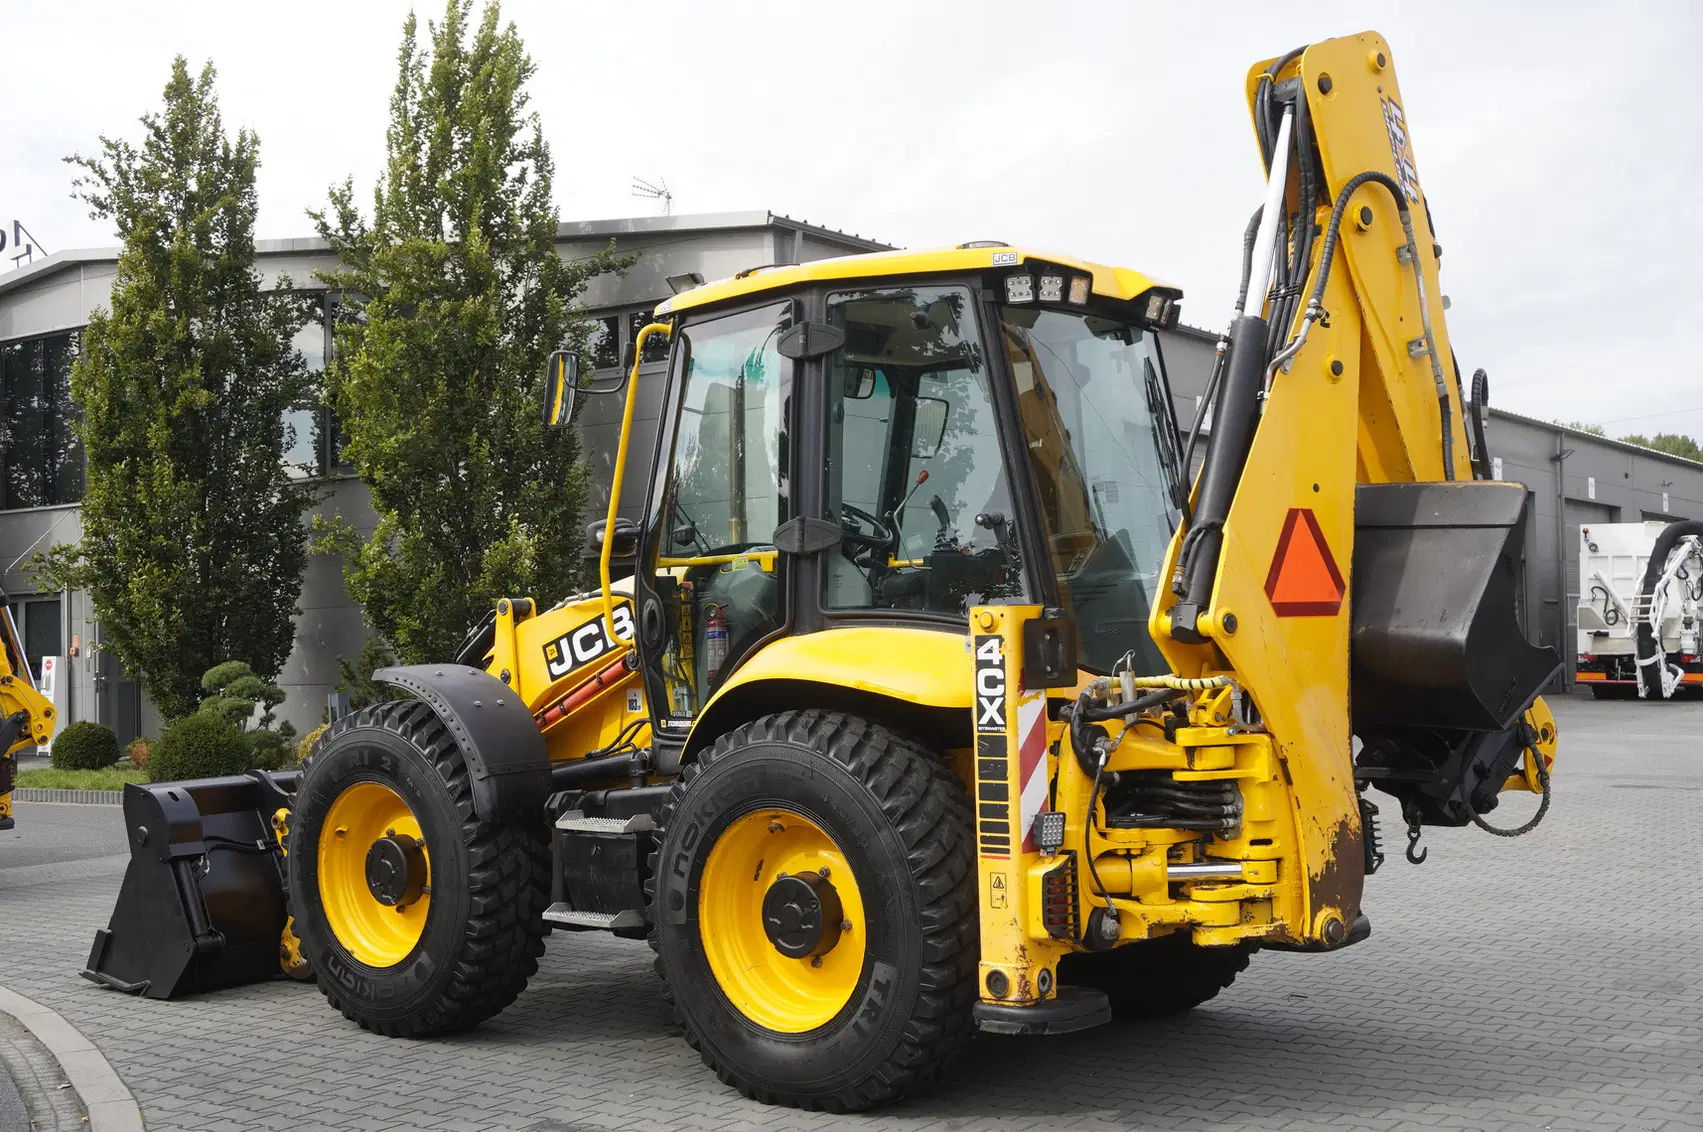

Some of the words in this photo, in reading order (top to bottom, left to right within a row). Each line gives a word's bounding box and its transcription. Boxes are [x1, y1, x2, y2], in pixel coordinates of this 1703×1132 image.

[995, 254, 1016, 263] JCB
[550, 606, 635, 676] JCB
[977, 638, 1005, 725] 4CX
